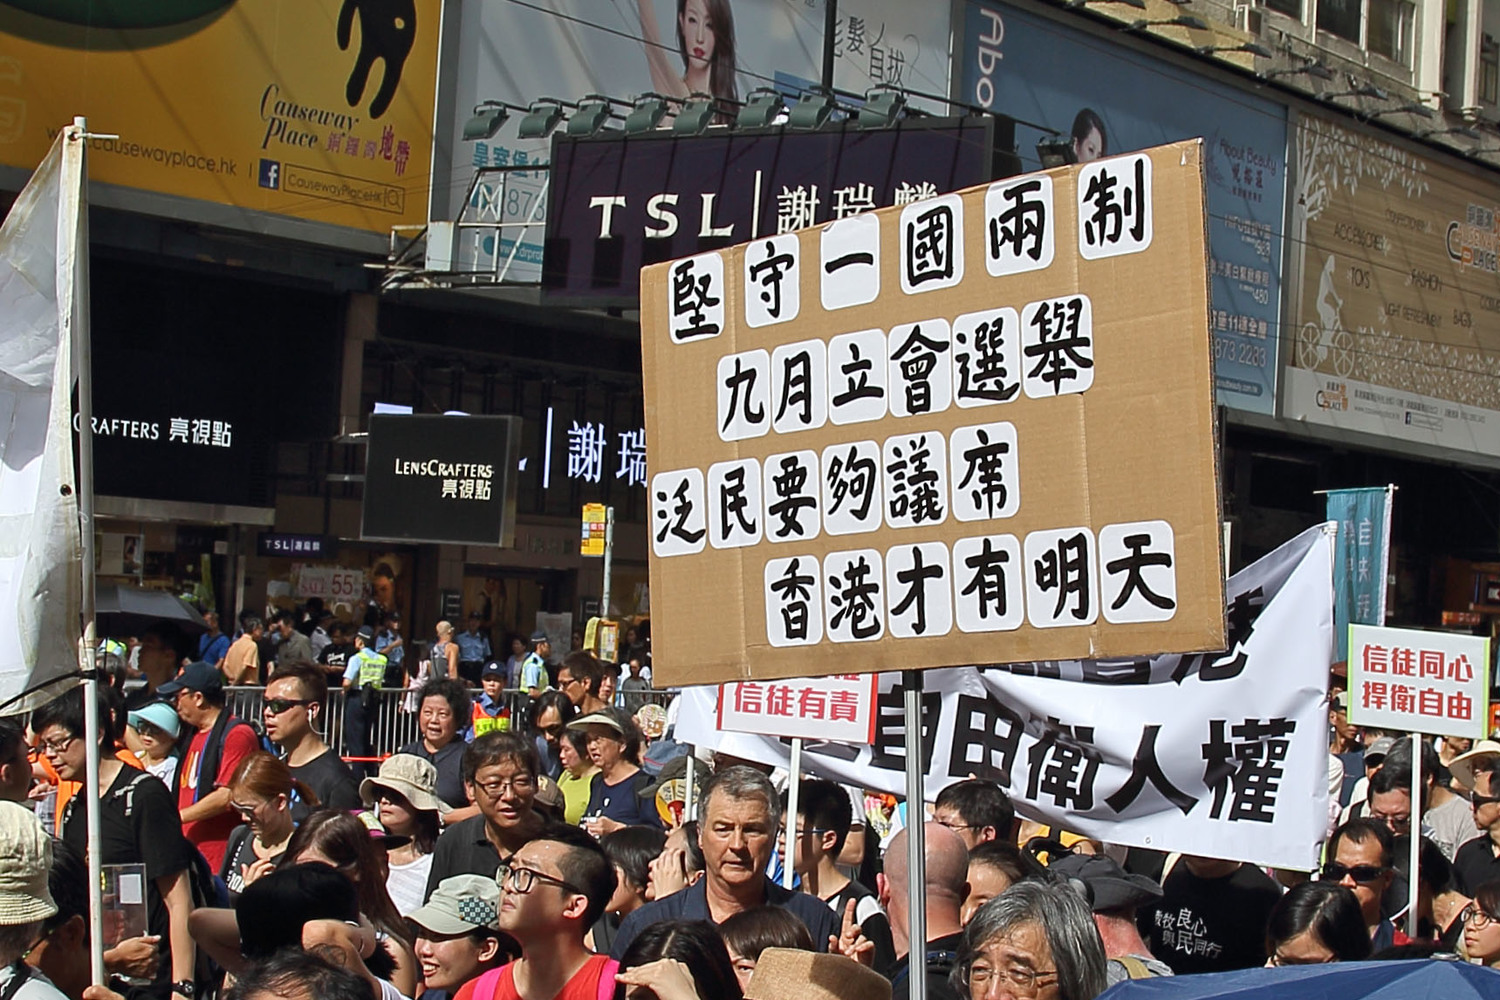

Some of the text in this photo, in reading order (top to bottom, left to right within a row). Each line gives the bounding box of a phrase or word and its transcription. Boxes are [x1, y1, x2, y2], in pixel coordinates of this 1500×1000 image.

[260, 83, 359, 136] Causeway
[262, 117, 318, 150] Place
[46, 126, 237, 178] w.causewayplace.hk
[589, 193, 735, 239] TSL
[673, 157, 1147, 341] 堅守一國兩制
[721, 296, 1095, 435] 九月立會選舉
[169, 417, 232, 447] 亮視點
[441, 479, 491, 500] 亮視點
[655, 428, 1011, 546] 泛民要夠議席
[770, 530, 1177, 642] 香港才有明天
[1362, 643, 1474, 681] 信徒同心
[734, 683, 860, 723] 信徒有責
[1361, 680, 1473, 721] 捍衛自由
[779, 684, 1297, 824] 自由衛人權
